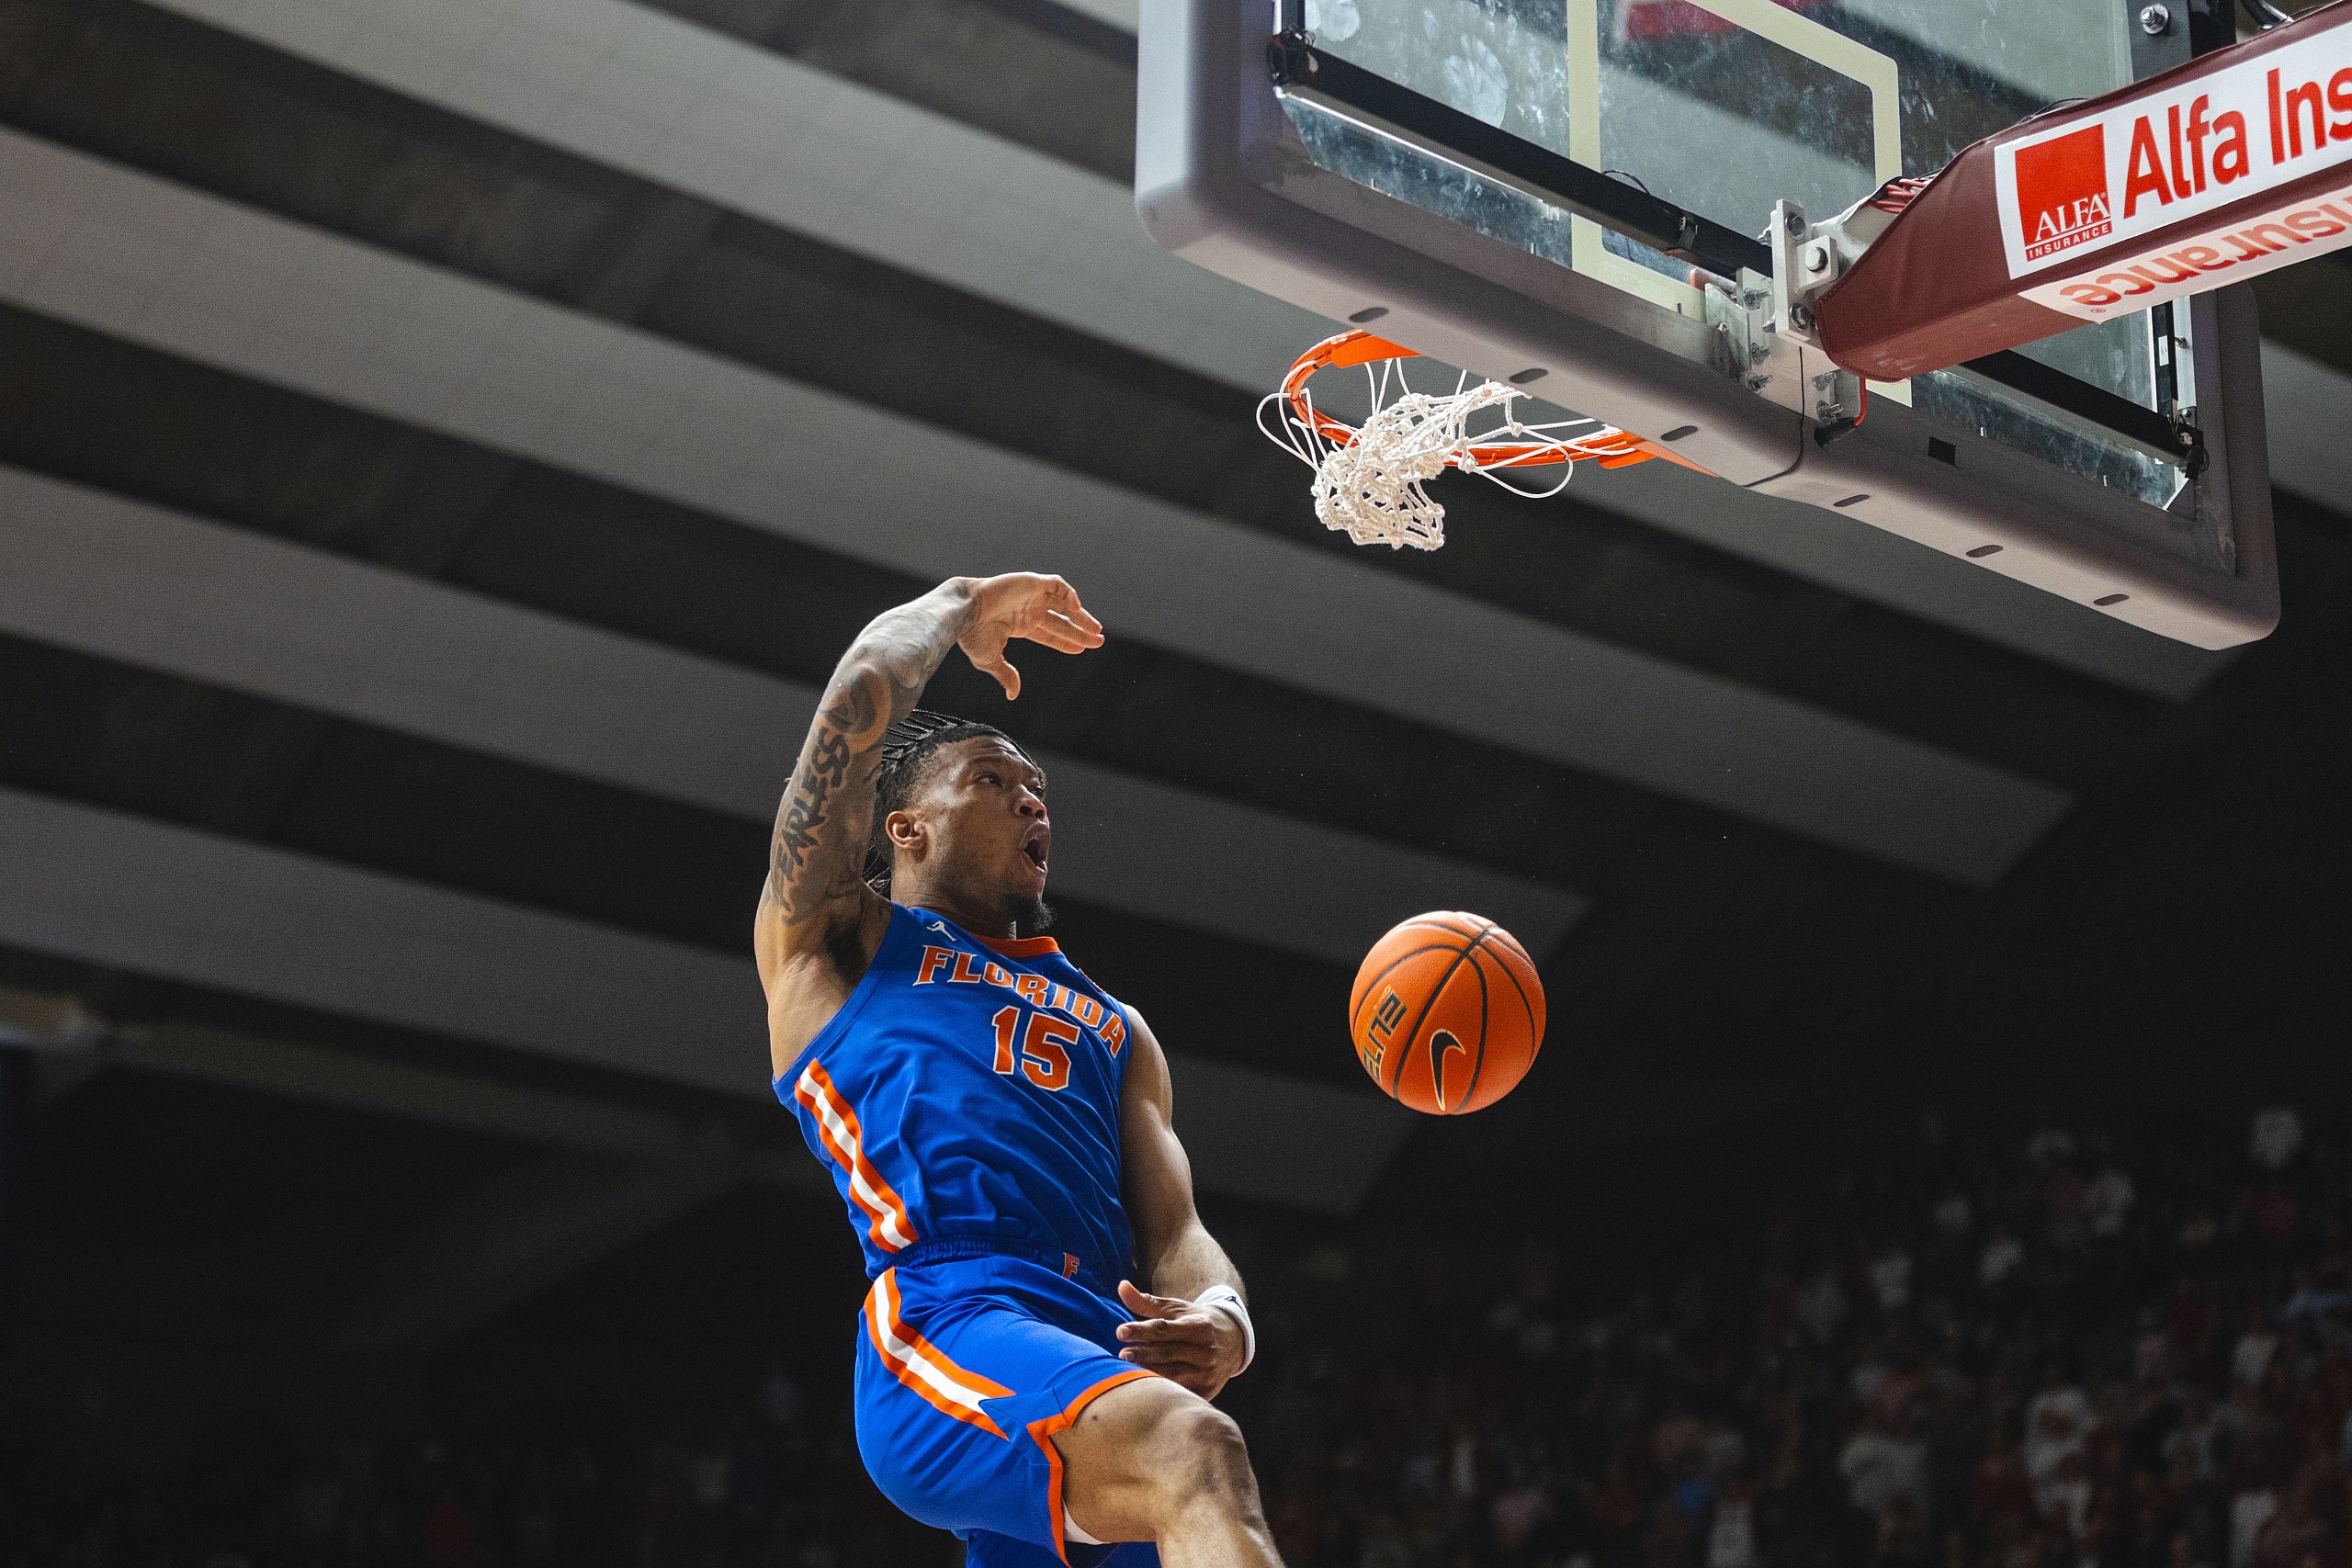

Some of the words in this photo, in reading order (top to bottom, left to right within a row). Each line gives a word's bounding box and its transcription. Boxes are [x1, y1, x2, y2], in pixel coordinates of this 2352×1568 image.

[2124, 94, 2250, 220] Alfa
[2267, 67, 2352, 165] Ins
[2030, 224, 2109, 259] INSURANCE
[2034, 193, 2111, 242] ALFA
[912, 944, 1125, 1058] FLORIDA
[1363, 990, 1408, 1084] ELITE
[991, 1005, 1080, 1091] 15
[1062, 1252, 1080, 1280] F
